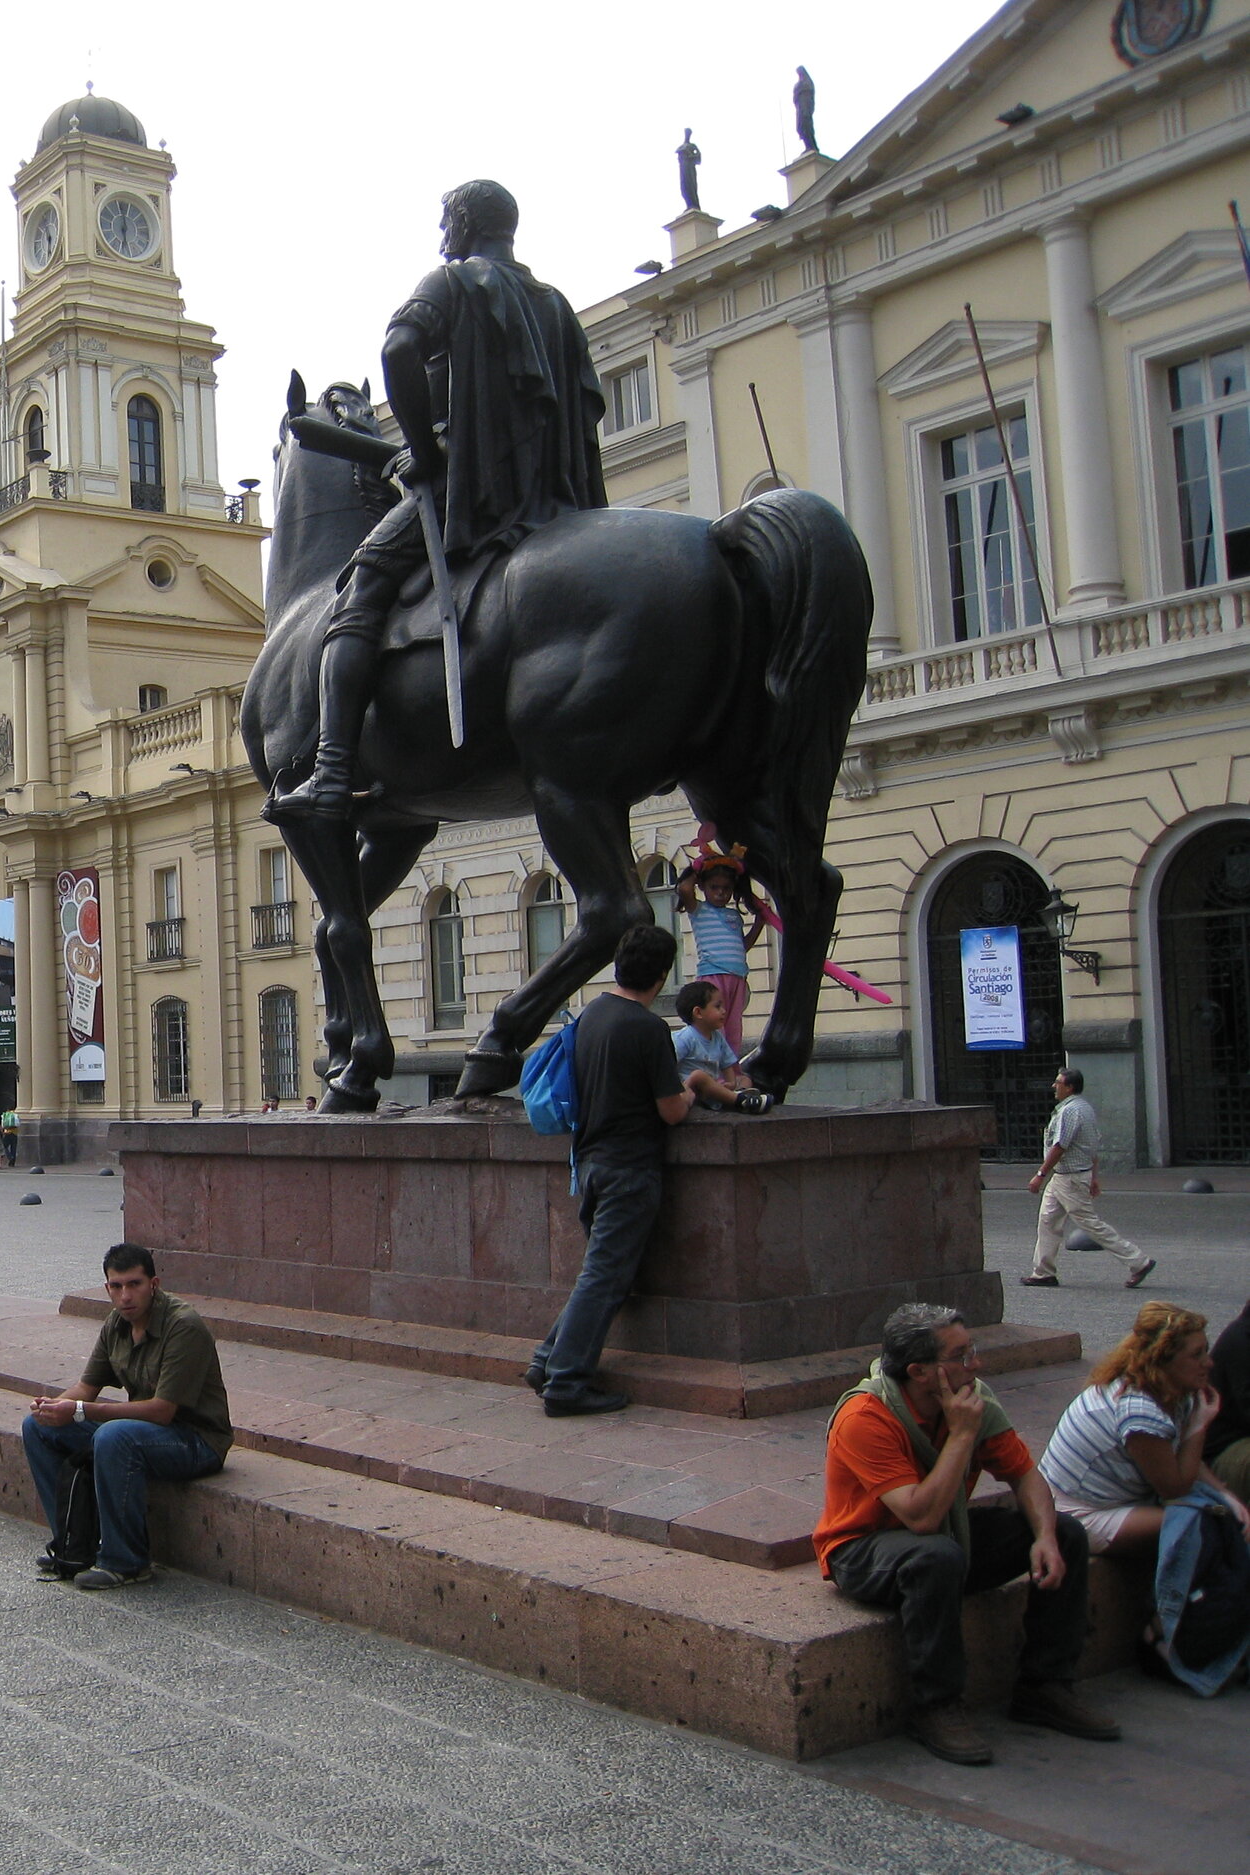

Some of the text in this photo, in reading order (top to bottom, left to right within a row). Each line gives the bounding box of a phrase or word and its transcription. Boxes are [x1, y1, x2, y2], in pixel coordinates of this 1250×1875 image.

[967, 966, 1000, 974] Permisos
[967, 972, 1013, 983] Circulación
[968, 982, 1013, 996] Santiago
